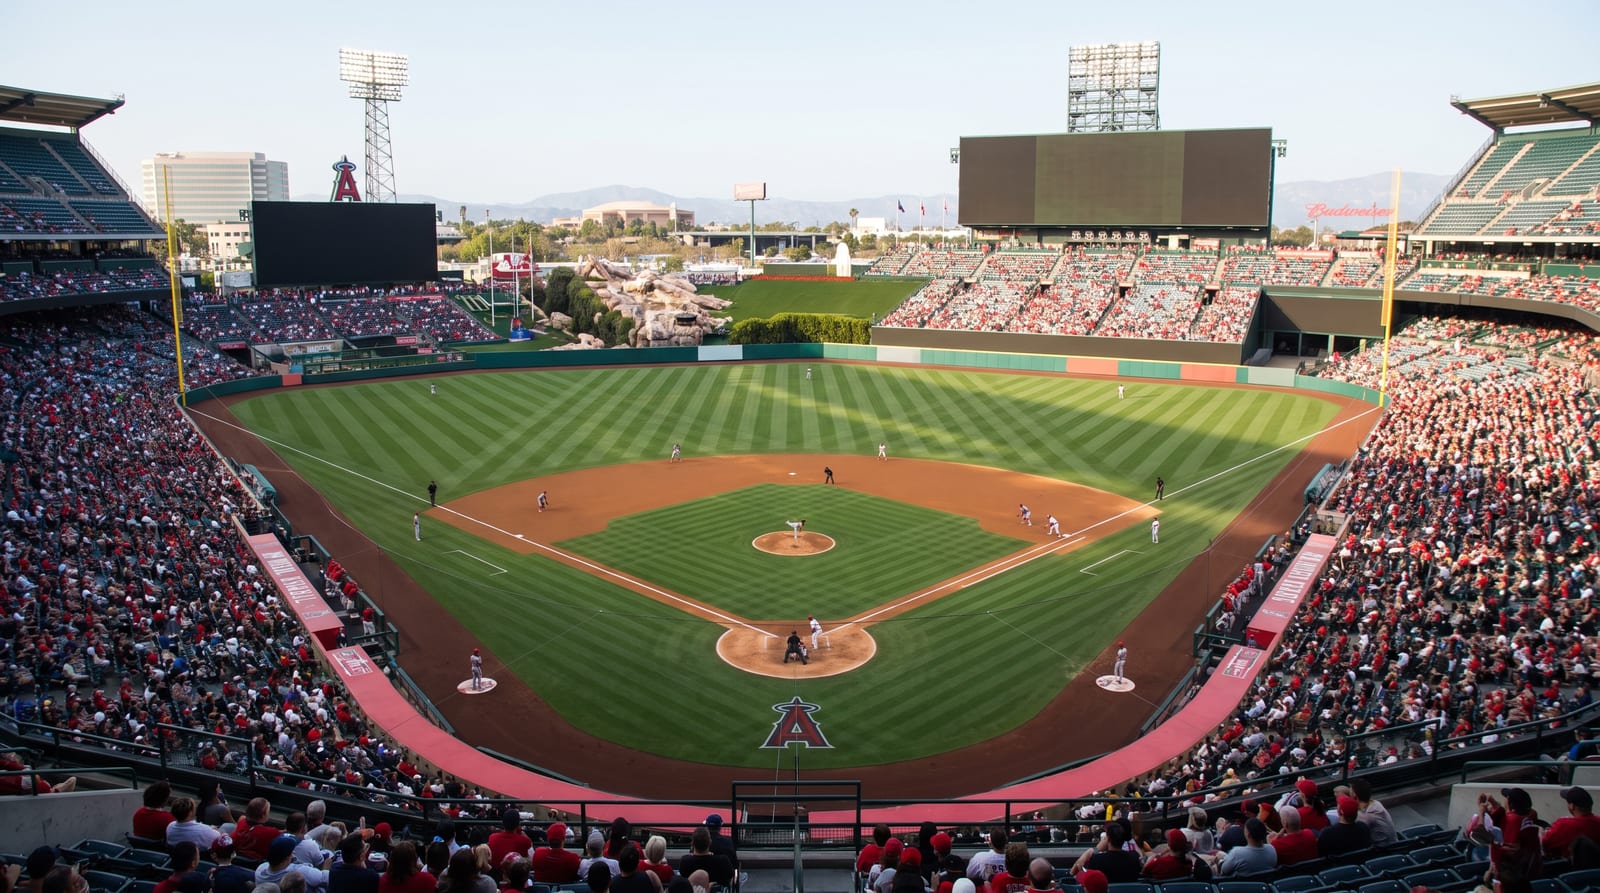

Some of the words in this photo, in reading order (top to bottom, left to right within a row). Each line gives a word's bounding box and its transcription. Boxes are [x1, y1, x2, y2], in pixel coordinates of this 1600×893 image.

[332, 155, 361, 201] A
[1305, 202, 1395, 217] Budweiser
[759, 696, 836, 749] A
